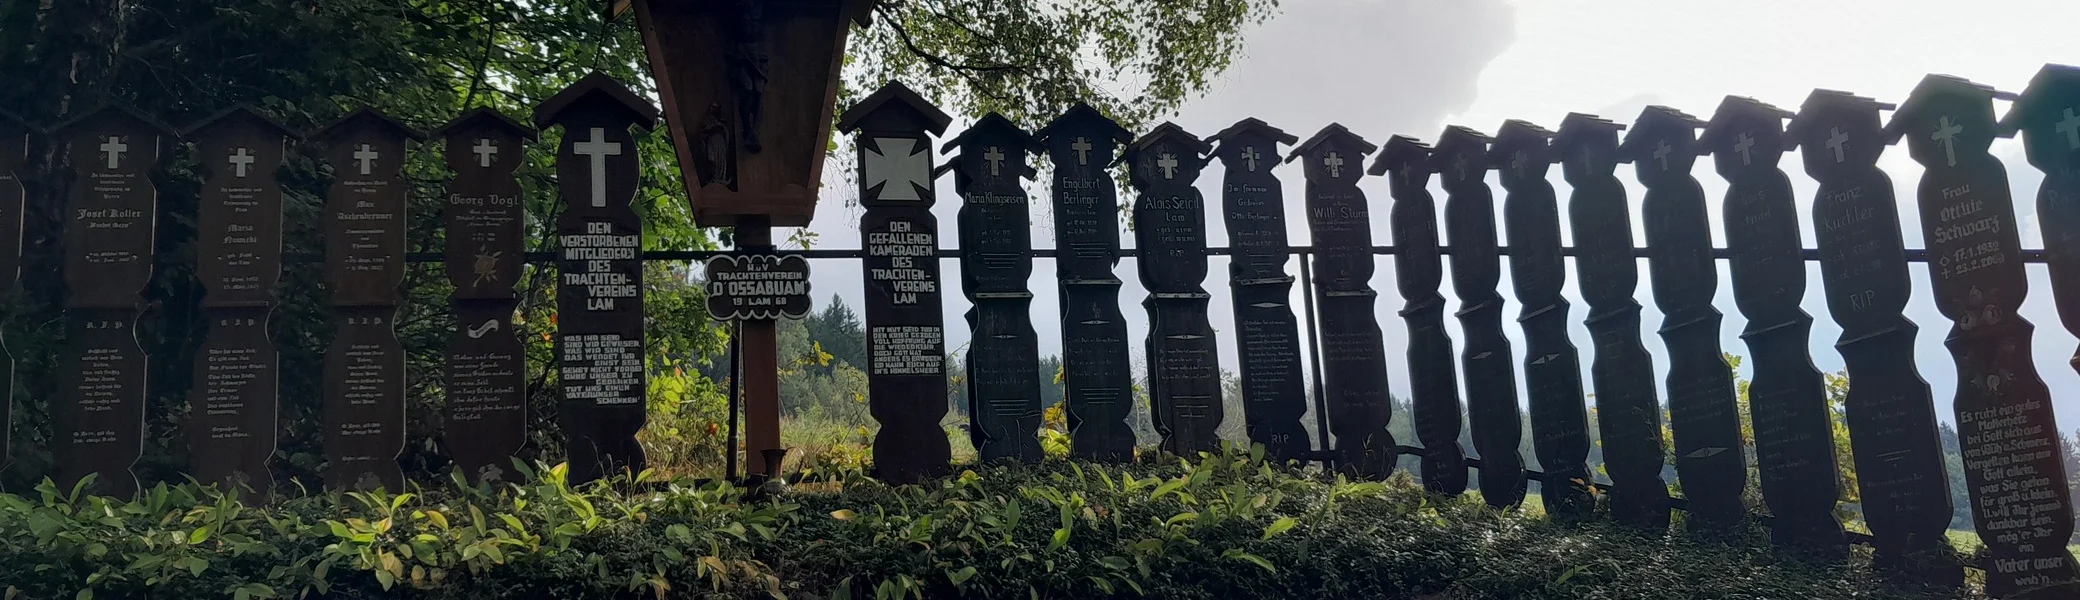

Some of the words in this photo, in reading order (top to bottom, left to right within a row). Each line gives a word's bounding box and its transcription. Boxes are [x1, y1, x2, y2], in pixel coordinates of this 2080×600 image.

[1062, 176, 1101, 193] Engelbert
[964, 191, 985, 204] Maria
[1941, 184, 1971, 200] Frau
[450, 193, 484, 207] Georg
[488, 194, 520, 208] Vogl
[1145, 196, 1171, 210] Alois
[1165, 211, 1186, 222] Lam
[1940, 199, 1984, 222] Ottilie
[587, 222, 612, 234] DEN
[889, 221, 911, 232] DEN
[1934, 214, 2001, 245] Schwarz
[559, 234, 639, 247] VERSTORBENEN
[869, 233, 933, 245] GEFALLENEN
[565, 247, 635, 260] MITGLIEDERN
[869, 245, 933, 256] KAMERADEN
[588, 260, 611, 272] DES
[892, 256, 913, 268] DES
[563, 272, 632, 286] TRACHTEN-
[716, 272, 803, 281] TRACHTENVEREIN
[871, 268, 931, 280] TRACHTEN-
[587, 285, 637, 297] VEREINS
[892, 280, 935, 292] VEREINS
[733, 297, 743, 306] 19
[748, 297, 771, 306] LAM
[775, 297, 787, 305] 68
[893, 292, 917, 304] LAM
[1850, 289, 1876, 312] RIP
[587, 298, 614, 311] LAM
[589, 372, 618, 380] UNSER
[565, 391, 620, 399] VATERUNSER
[1960, 411, 1973, 424] Es
[1974, 406, 1998, 421] ruht
[1998, 402, 2014, 416] ein
[2014, 398, 2041, 417] gutes
[1271, 433, 1290, 445] RIP
[1966, 432, 1981, 445] bei
[1982, 430, 2003, 443] Gott
[2023, 424, 2042, 436] aus
[1963, 448, 1981, 459] von
[1982, 467, 2005, 482] Gott
[1980, 483, 2000, 495] was
[2001, 479, 2018, 492] Sie
[2020, 475, 2050, 492] getan
[1986, 517, 2029, 531] dankbar
[2018, 541, 2035, 553] ein
[1994, 558, 2031, 574] Vater
[2033, 556, 2065, 570] unser
